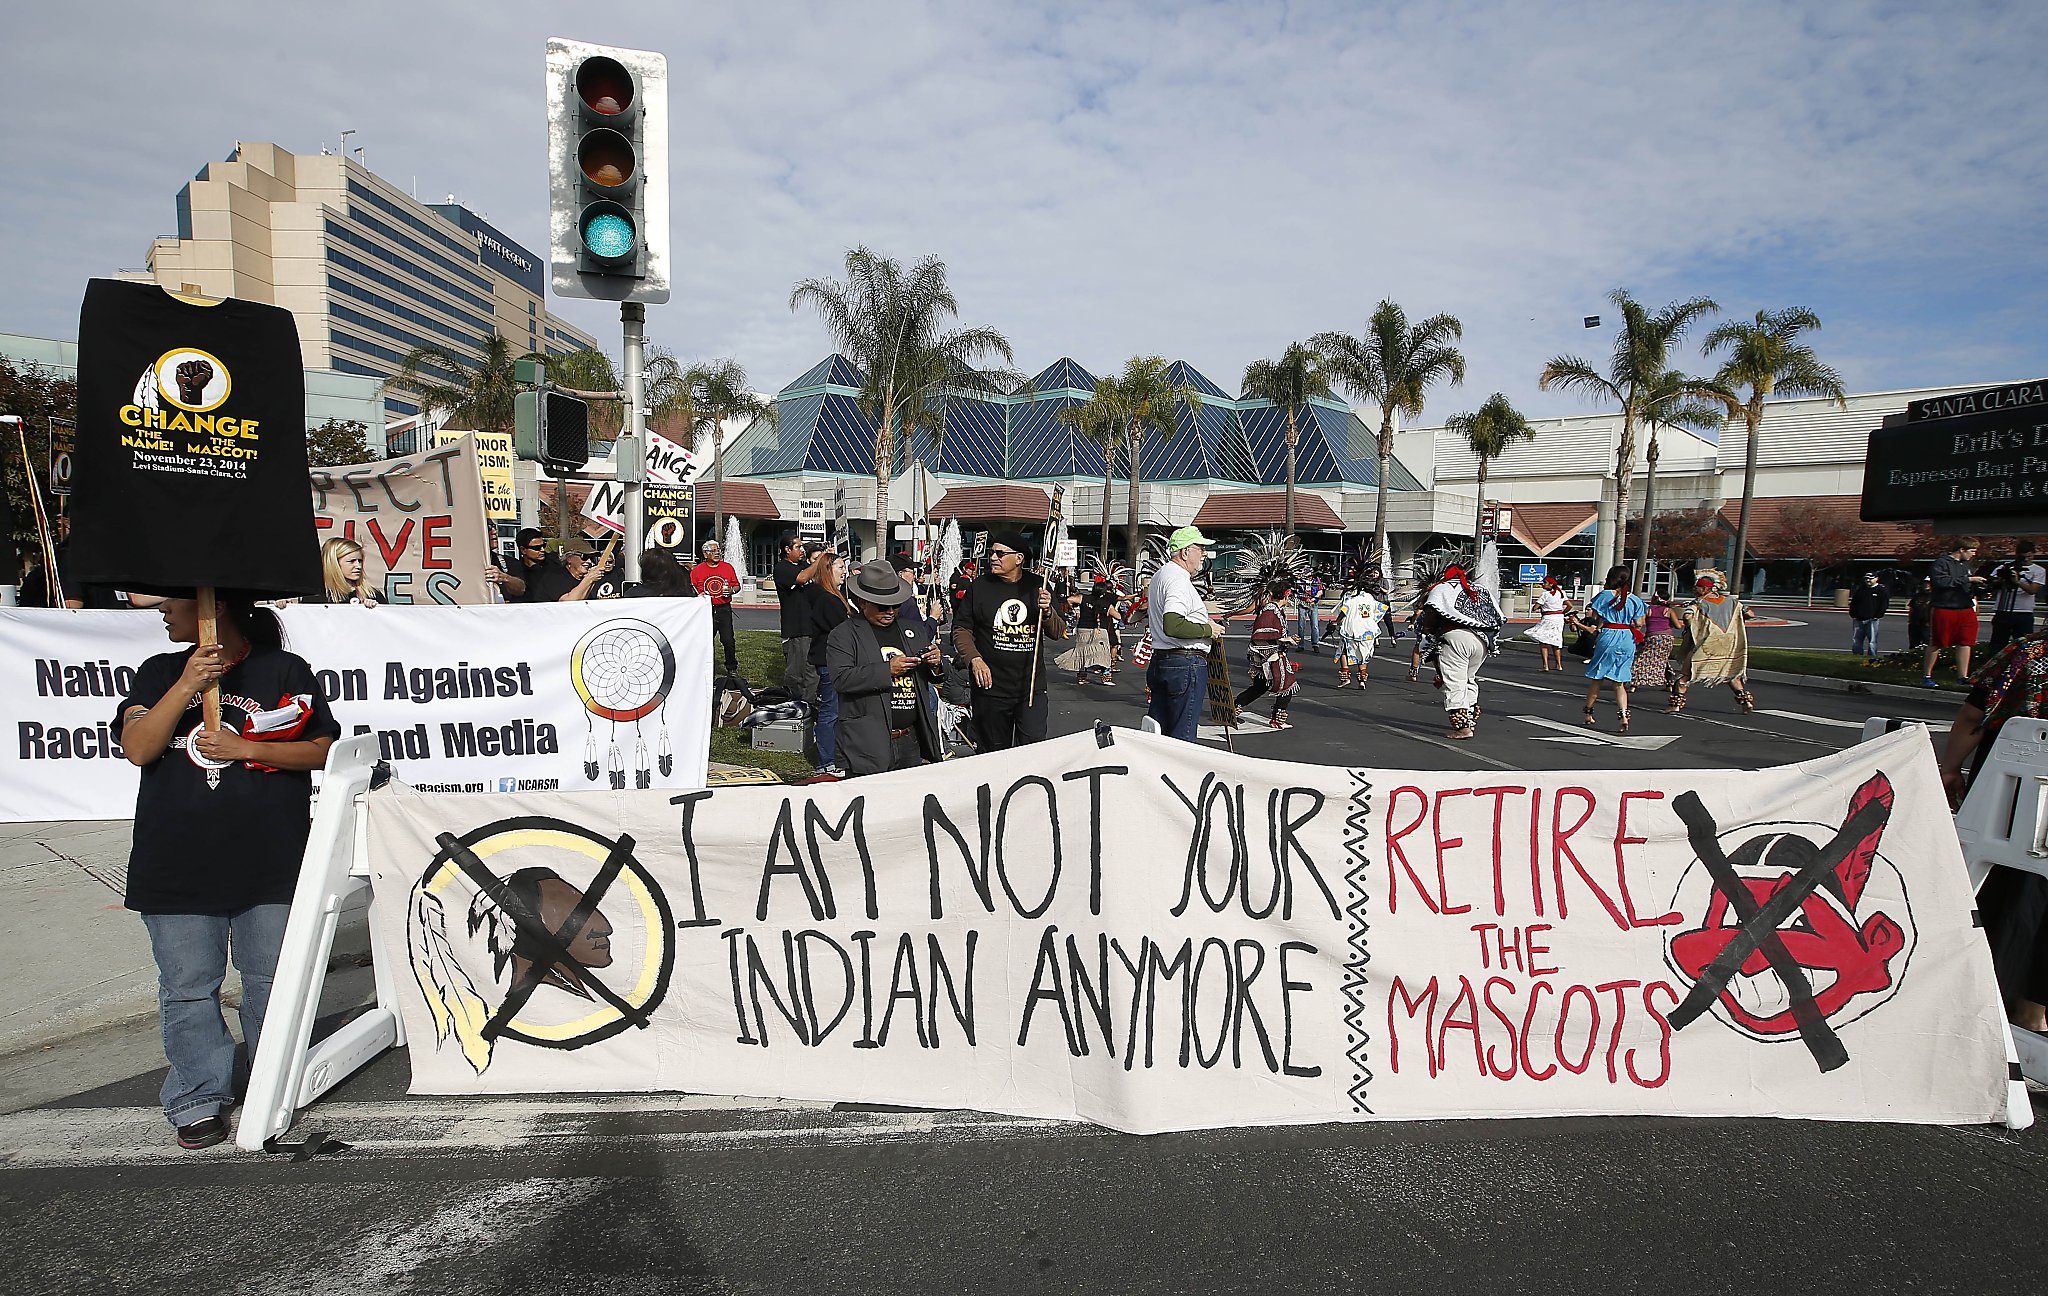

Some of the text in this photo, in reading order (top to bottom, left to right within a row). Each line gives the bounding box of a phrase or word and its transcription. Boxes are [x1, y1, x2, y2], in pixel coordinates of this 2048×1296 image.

[1921, 385, 2044, 419] SANTA CLARA
[119, 404, 260, 441] CHANGE
[121, 435, 174, 451] NAME!
[136, 429, 162, 439] THE
[210, 437, 235, 447] THE
[1952, 429, 2023, 454] Erik's
[187, 443, 258, 459] MASCOT!
[477, 439, 508, 451] ONOR
[132, 462, 150, 470] Levi
[152, 464, 209, 475] Stadium-Santa
[210, 470, 234, 479] Clara,
[133, 450, 247, 471] November 23, 2014
[479, 455, 510, 468] CISM:
[646, 445, 697, 483] ANGE
[310, 447, 461, 513] PECT
[1888, 456, 2048, 487] Espresso Bar, Pa
[497, 483, 511, 495] the
[591, 482, 625, 516] N
[643, 490, 693, 500] CHANGE
[1950, 482, 2013, 502] Lunch
[2019, 482, 2035, 498] &
[648, 506, 689, 518] NAME!
[802, 510, 821, 518] Indian
[800, 522, 825, 531] Mascots!
[384, 572, 462, 605] ES
[992, 625, 1036, 634] CHANGE
[35, 658, 533, 703] Natio on Against
[18, 721, 126, 759] Racis
[440, 718, 559, 758] Media
[411, 781, 484, 793] tRacism.org
[518, 778, 559, 791] NCARSM
[669, 766, 1342, 928] I AM NOT YOUR
[1386, 785, 1684, 931] RETIRE
[1471, 922, 1560, 978] THE
[720, 924, 1322, 1079] INDIAN ANYMORE
[1387, 974, 1680, 1090] MASCOTS
